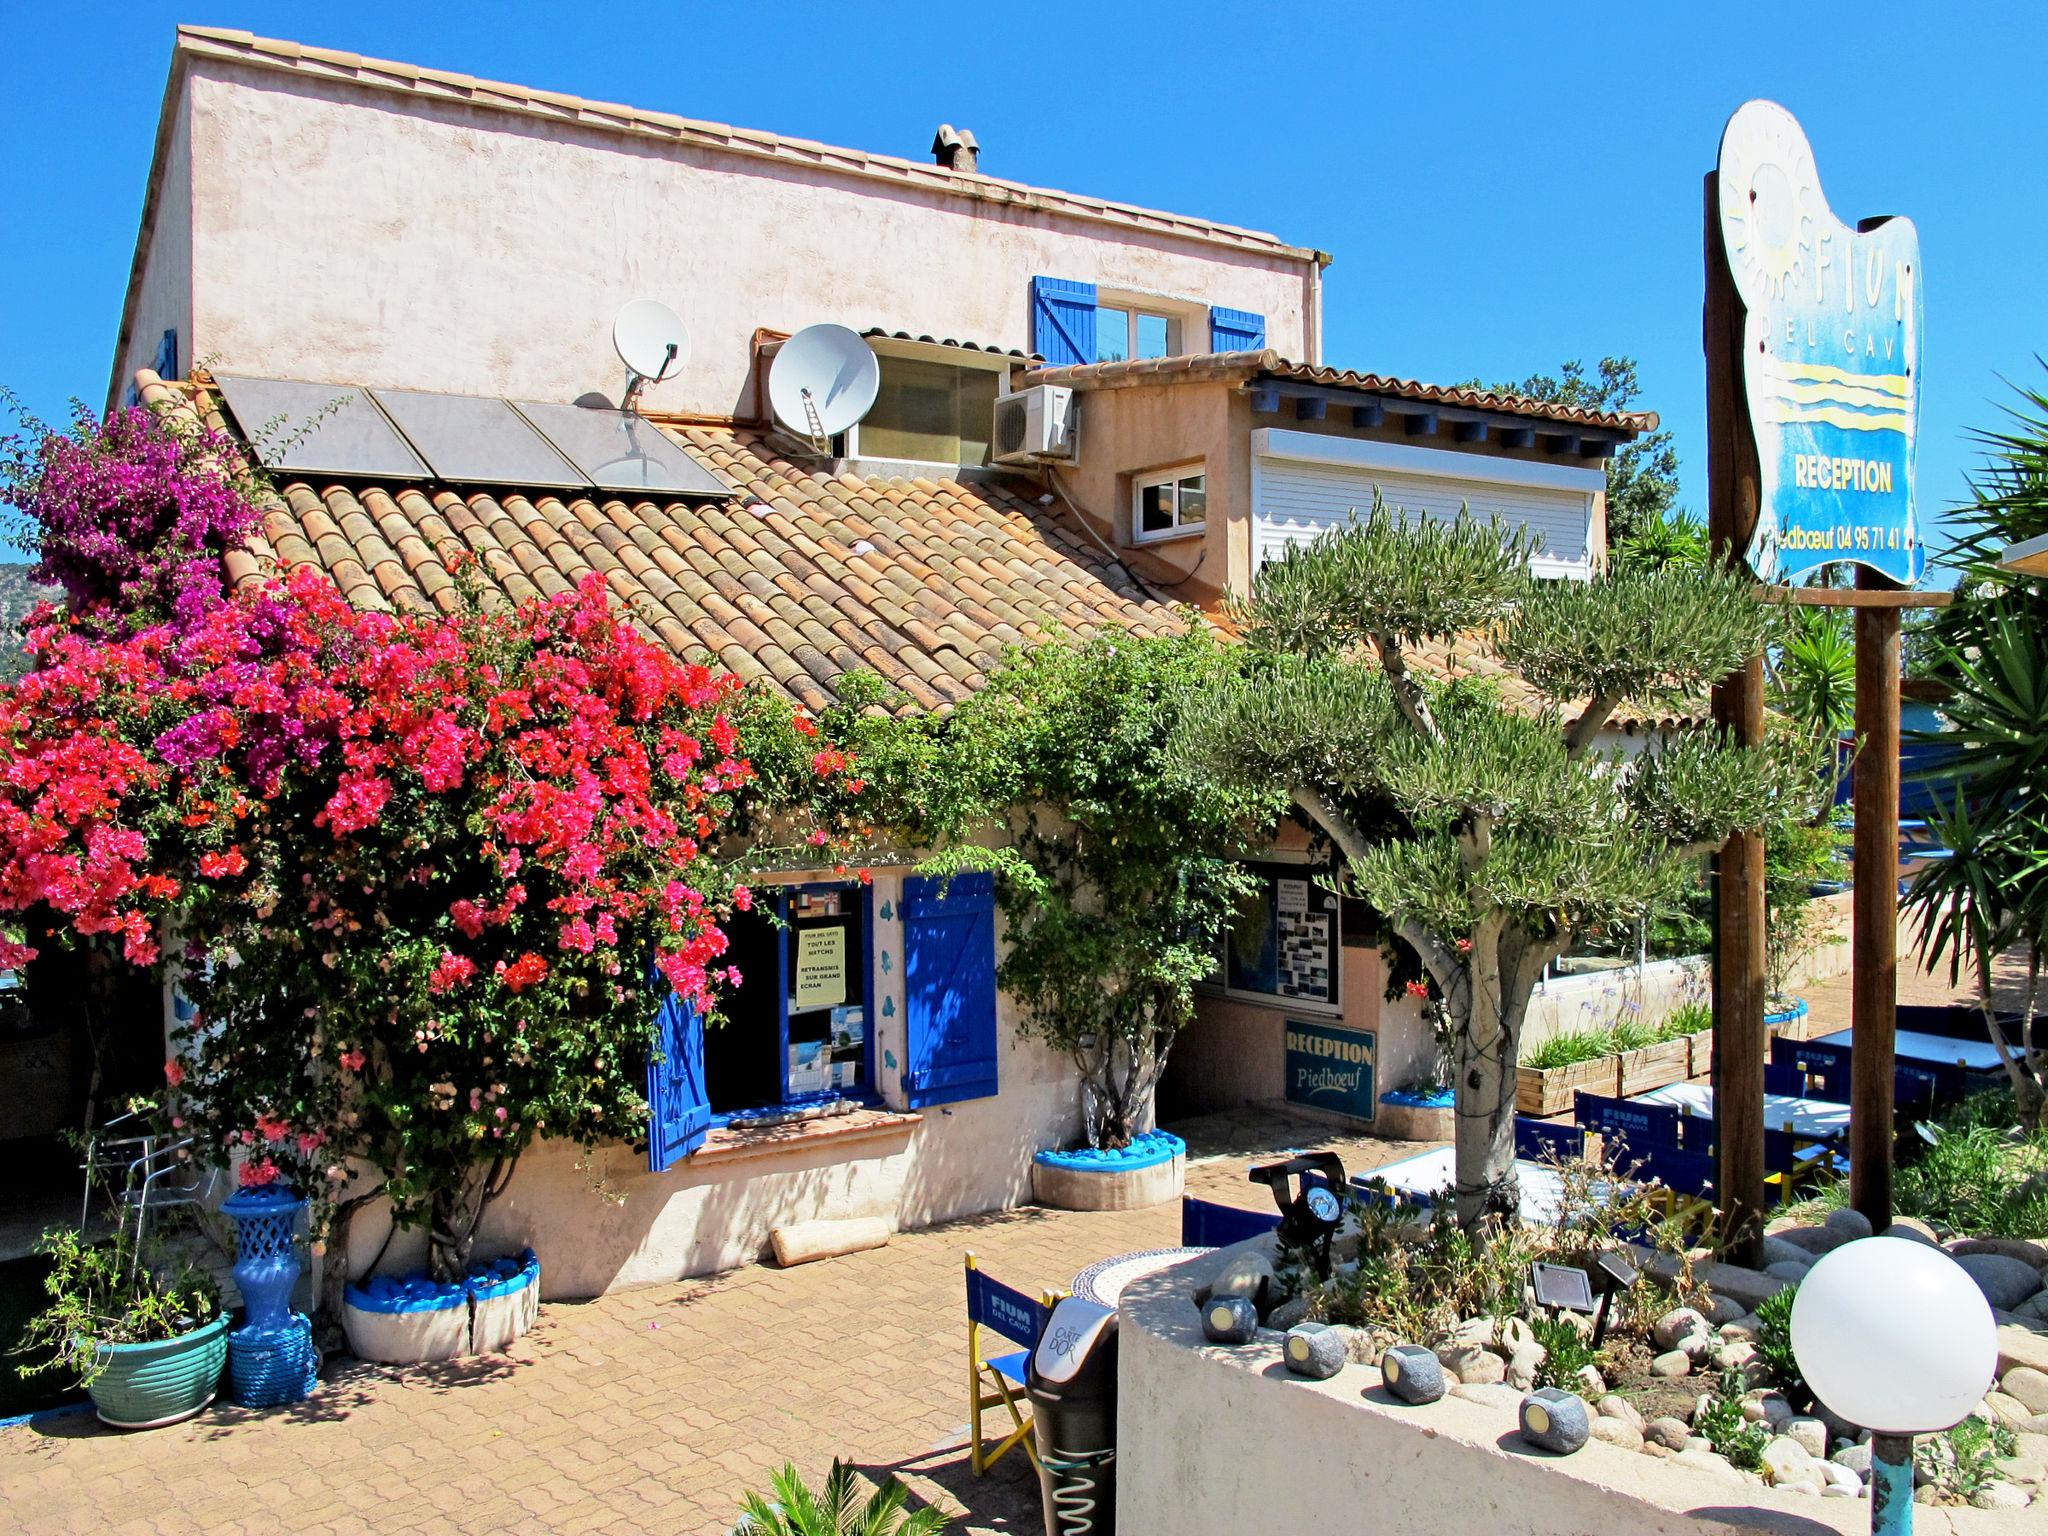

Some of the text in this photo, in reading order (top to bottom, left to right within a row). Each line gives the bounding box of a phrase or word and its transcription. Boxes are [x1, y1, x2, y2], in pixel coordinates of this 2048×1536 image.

[1815, 230, 1914, 333] FIUM
[1762, 316, 1816, 347] DEL
[1795, 454, 1892, 493] RECEPTION
[1837, 526, 1852, 549] 04
[1855, 527, 1869, 549] 95
[1872, 527, 1884, 549] 71
[1888, 527, 1899, 550] 41
[1286, 1032, 1373, 1066] RECEPTION
[1603, 1108, 1648, 1125] FIUM
[991, 1294, 1031, 1326] FIUM
[992, 1308, 1031, 1334] DEL CAVO
[1055, 1326, 1082, 1342] CARTE
